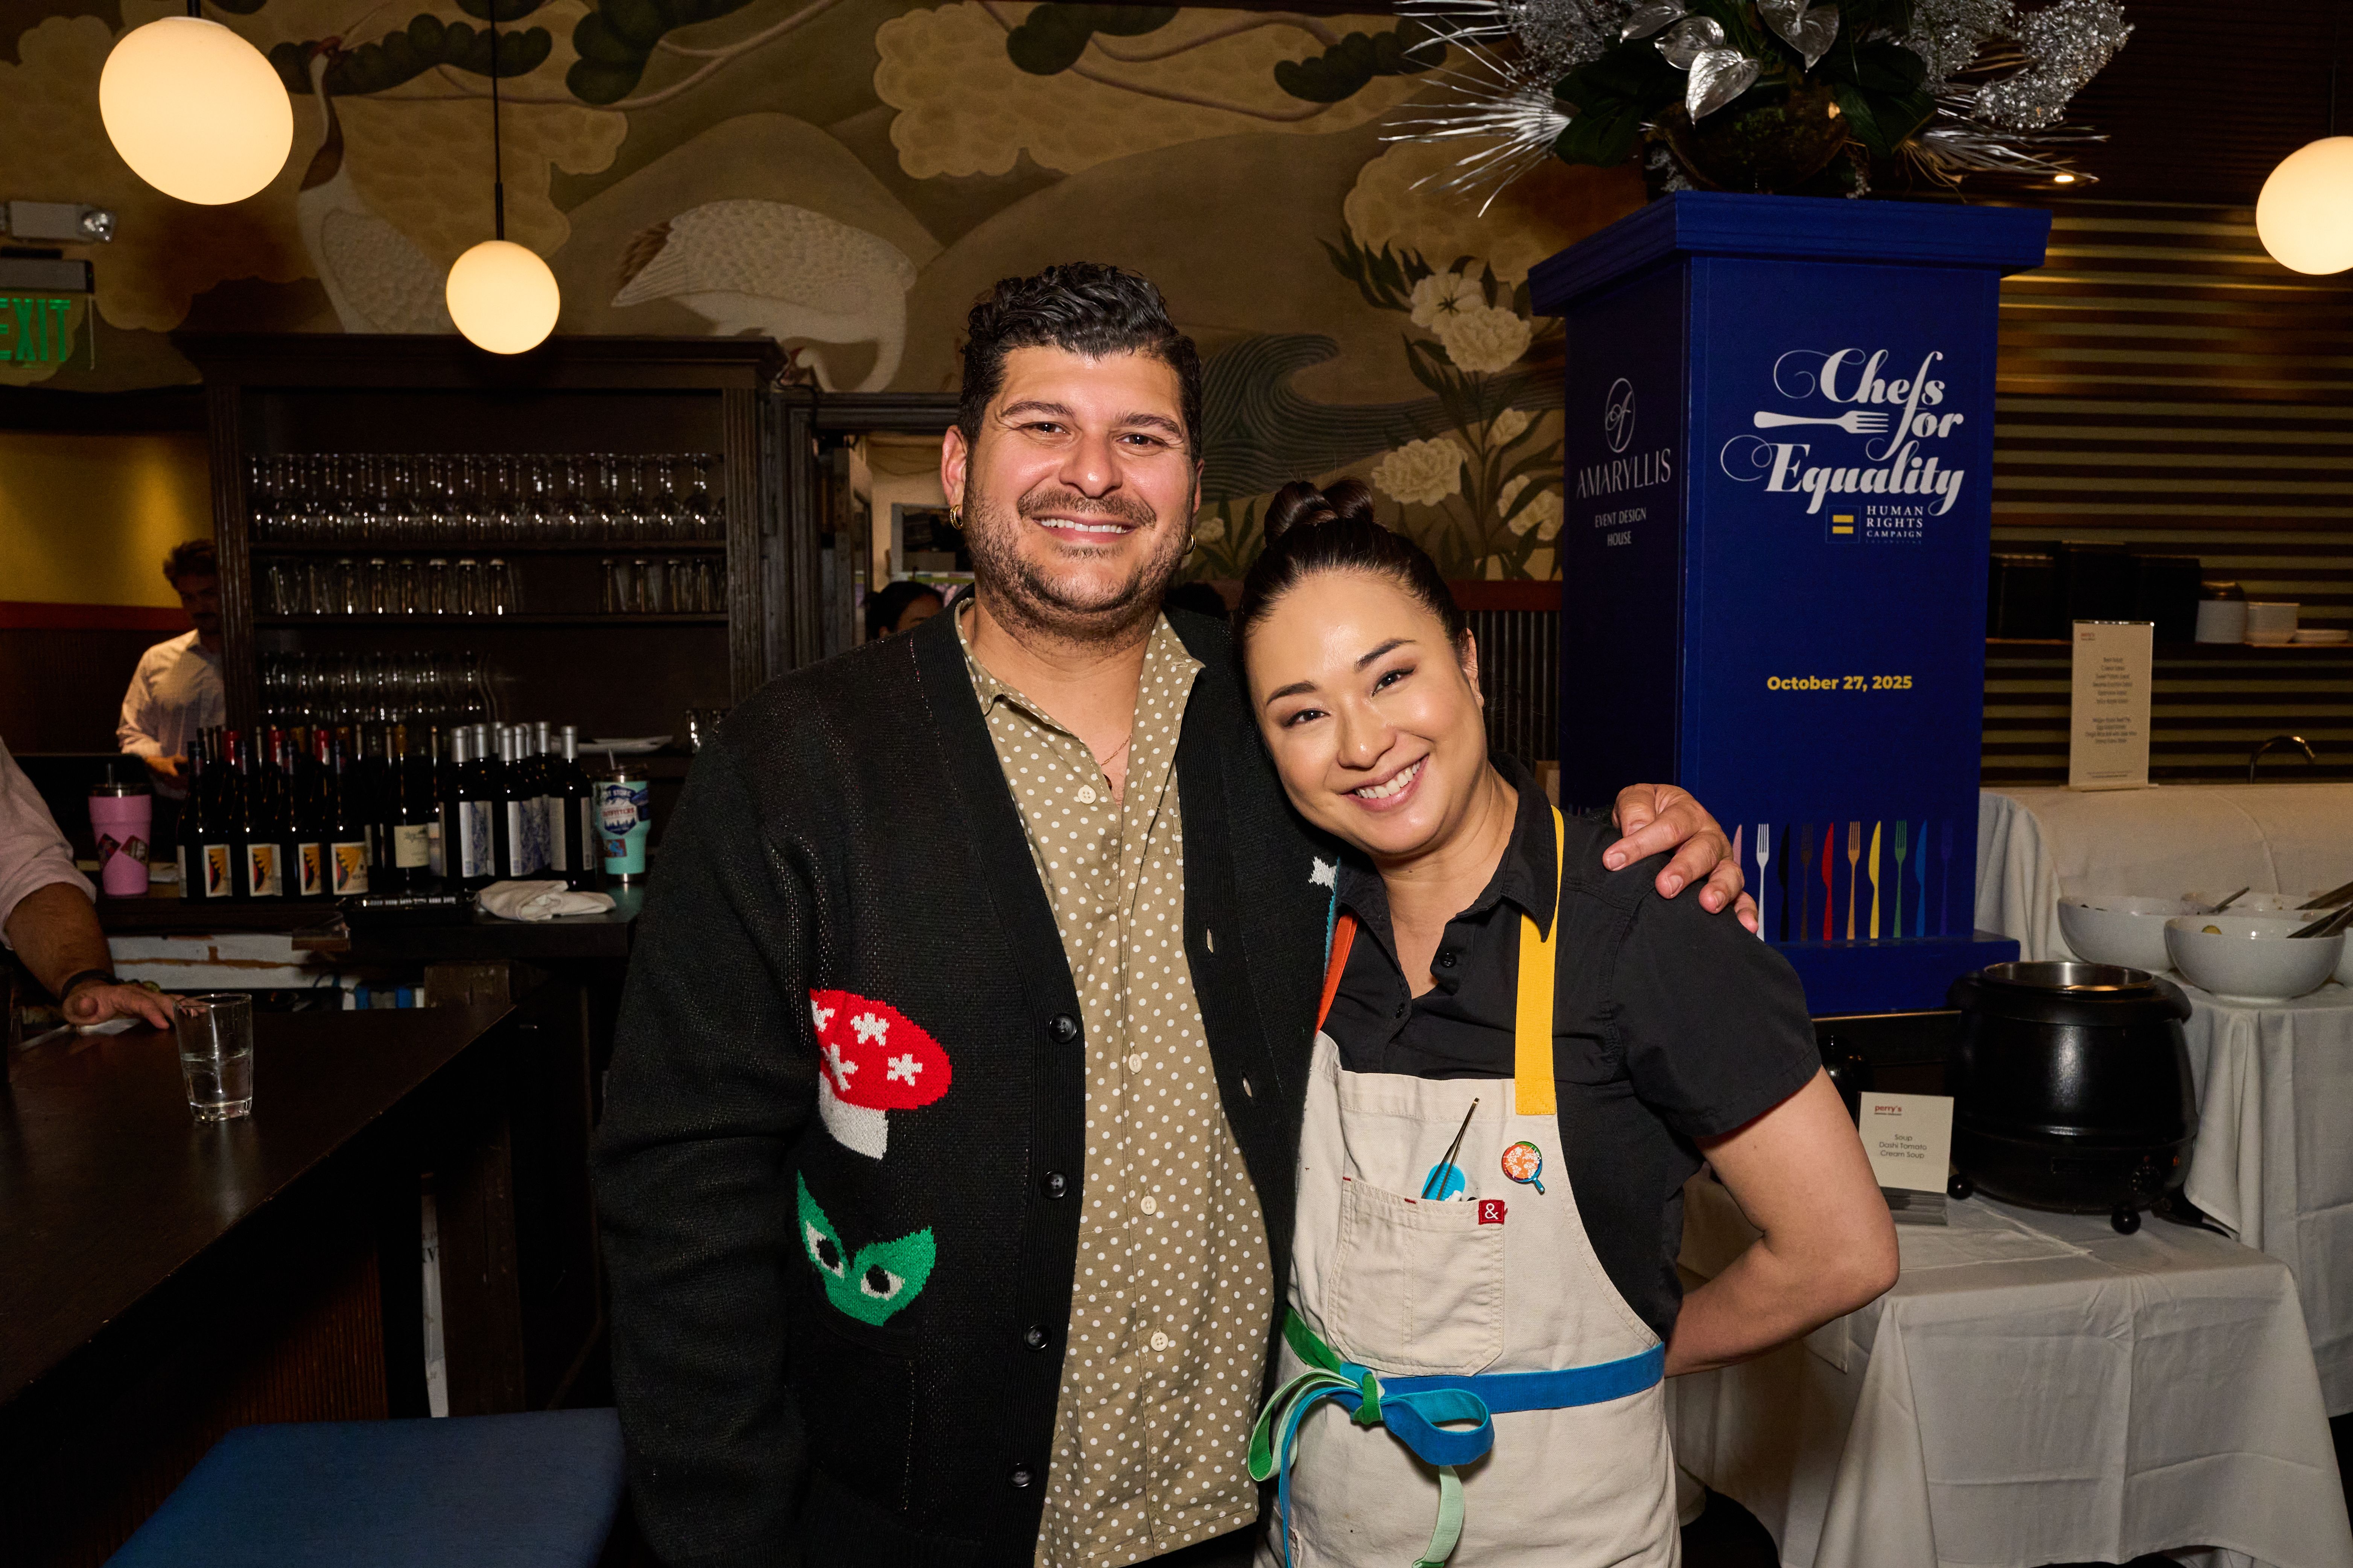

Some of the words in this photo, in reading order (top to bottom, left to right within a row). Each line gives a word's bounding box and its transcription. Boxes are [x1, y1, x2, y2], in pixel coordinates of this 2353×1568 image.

[1773, 348, 1945, 409] Chefs
[1866, 401, 1964, 461] for
[1577, 448, 1671, 499] AMARYLLIS
[1720, 440, 1964, 516] Equality
[1595, 512, 1617, 527] EVENT
[1619, 507, 1646, 524] DESIGN
[1867, 506, 1923, 515] HUMAN
[1866, 518, 1923, 528] RIGHTS
[1608, 531, 1632, 547] HOUSE
[1767, 676, 1839, 690] October
[1843, 676, 1868, 692] 27,
[1872, 676, 1912, 689] 2025
[1485, 1203, 1498, 1220] &
